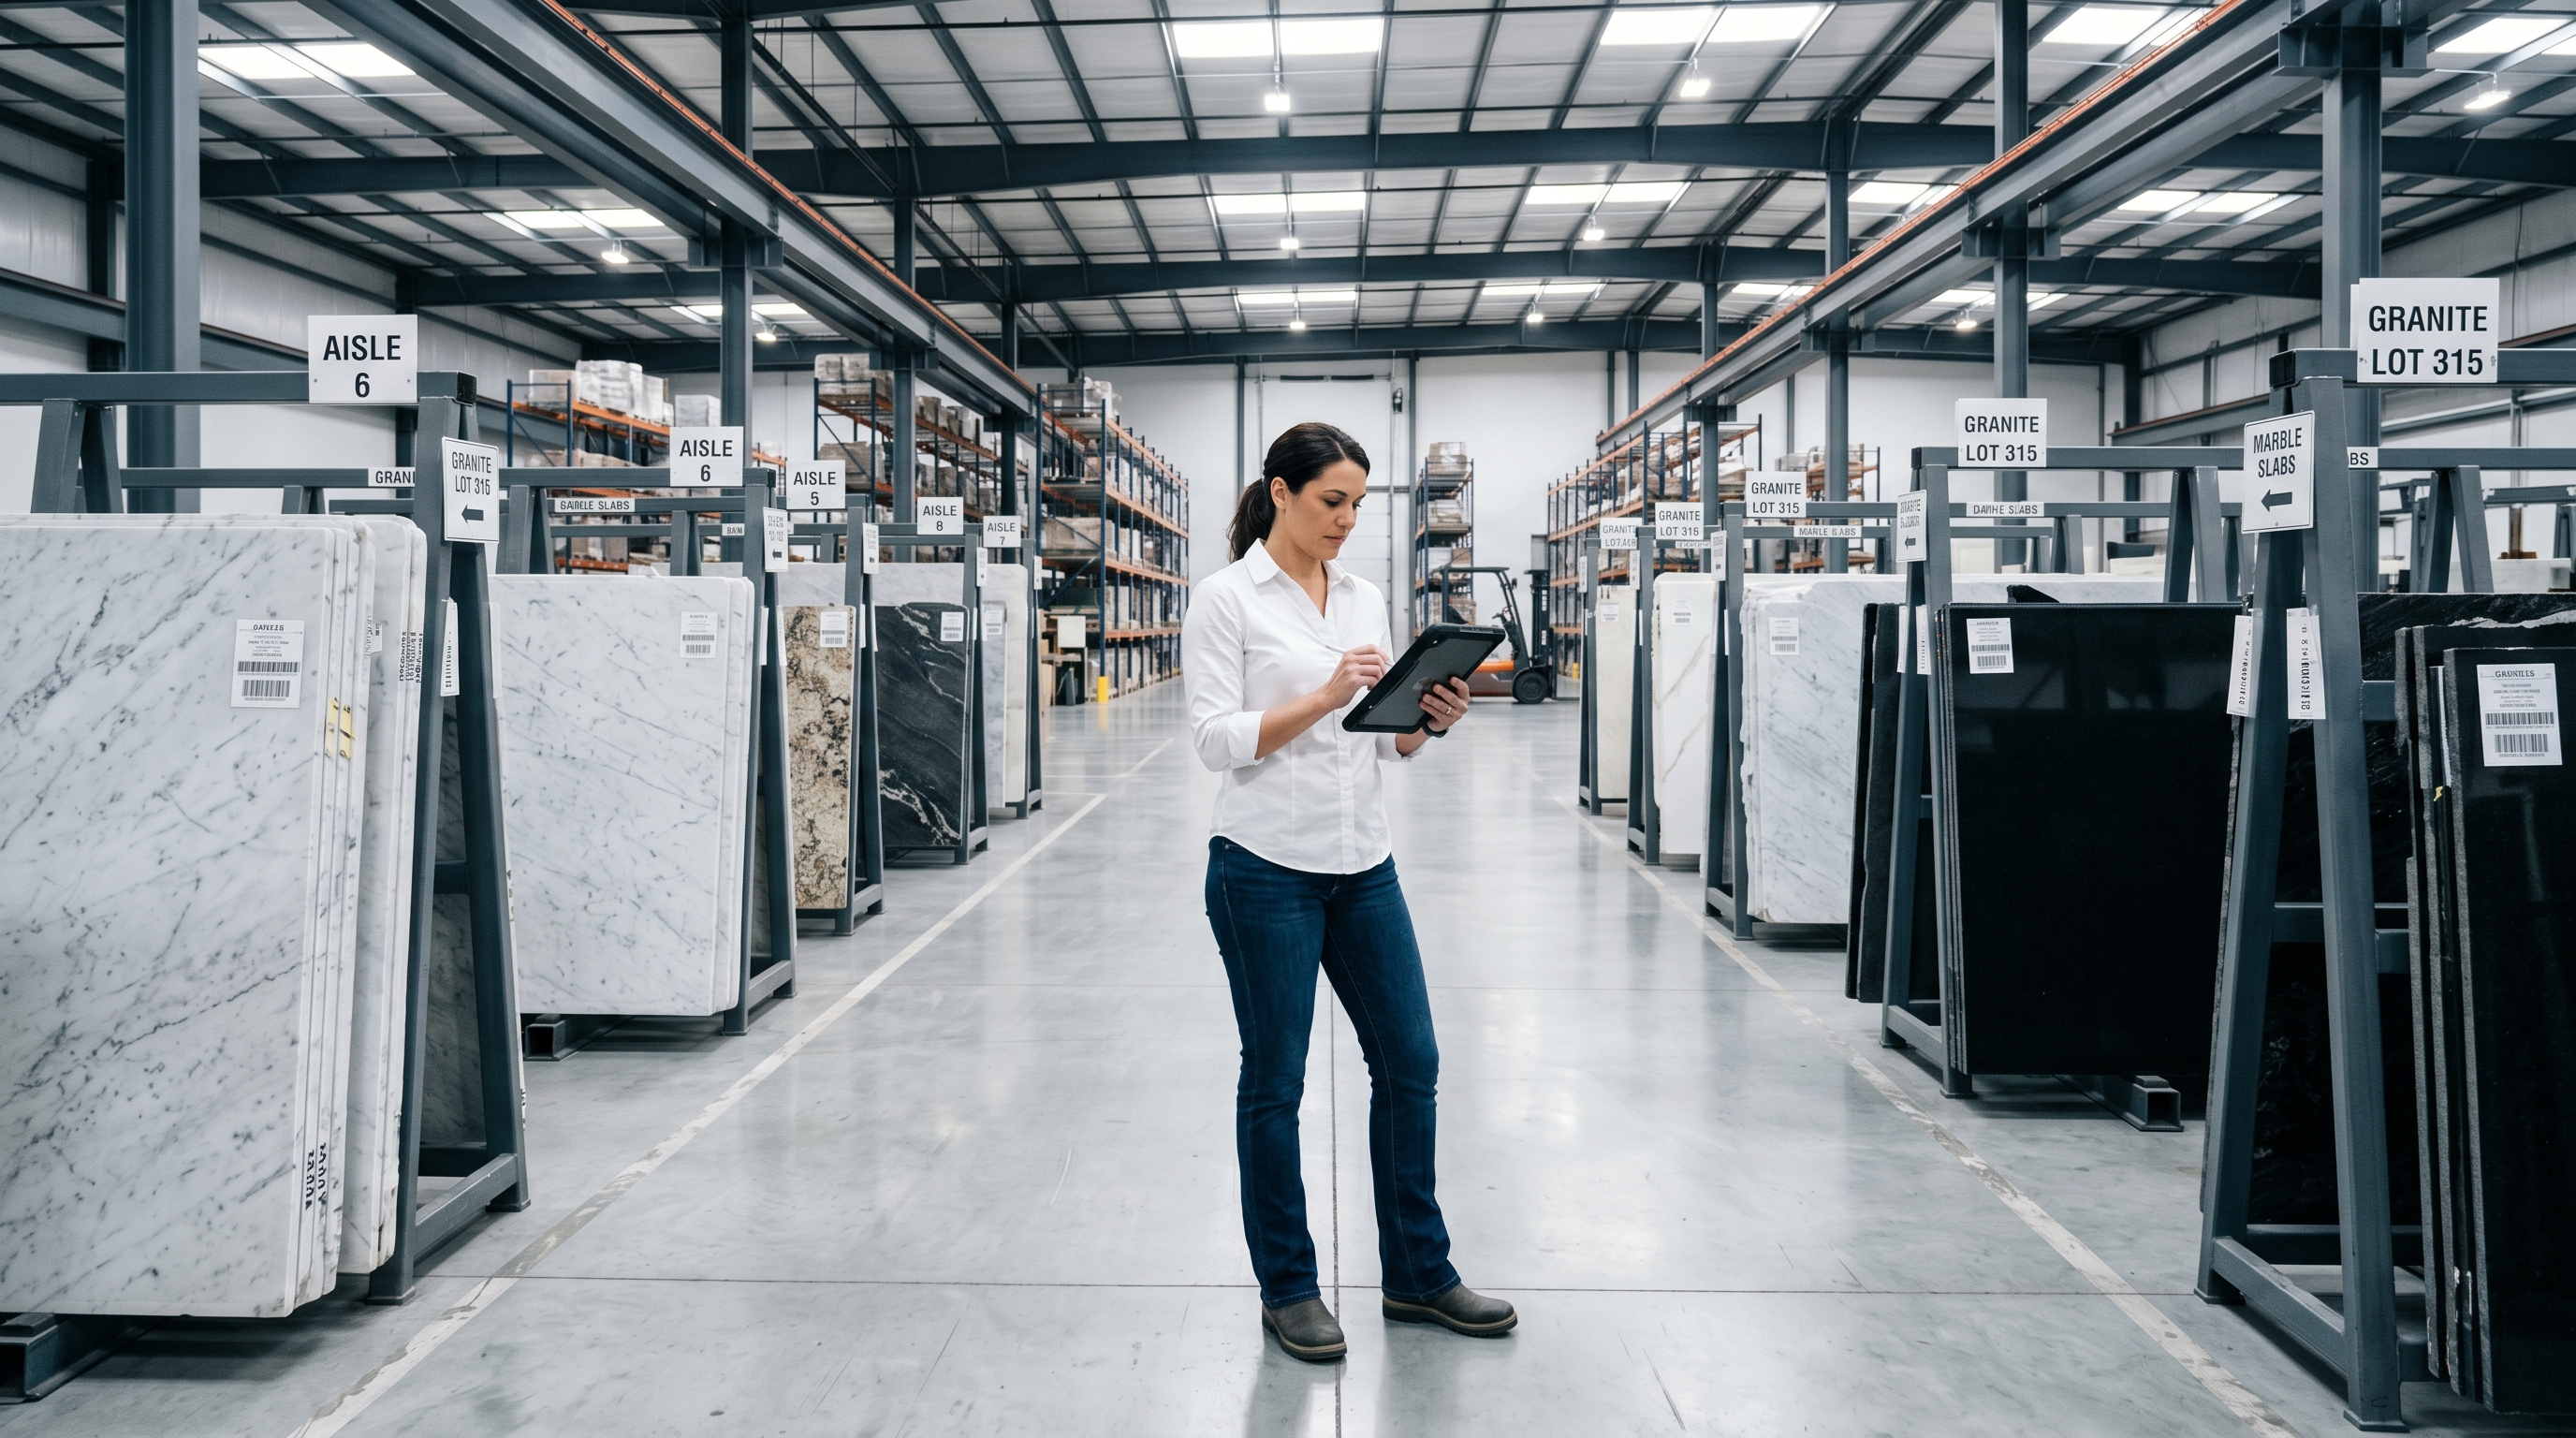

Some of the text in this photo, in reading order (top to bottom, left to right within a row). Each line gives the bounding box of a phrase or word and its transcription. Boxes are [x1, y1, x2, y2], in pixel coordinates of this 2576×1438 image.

[2368, 305, 2488, 332] GRANITE
[323, 334, 402, 361] AISLE
[2372, 348, 2483, 375] LOT 315
[355, 373, 371, 398] 6
[1964, 416, 2040, 433] GRANITE
[680, 439, 733, 458] AISLE
[2253, 427, 2303, 454] MARBLE
[1966, 444, 2038, 462] LOT 315
[451, 451, 491, 474] GRANITE
[2258, 454, 2296, 478] SLABS
[700, 464, 711, 482] 6
[793, 471, 837, 486] AISLE
[455, 475, 472, 493] LOT
[1751, 481, 1802, 495] GRANITE
[598, 500, 630, 510] SLABS
[811, 492, 820, 506] 5
[923, 506, 958, 517] AISLE
[1659, 510, 1701, 521] GRANITE
[1752, 502, 1800, 514] LOT 315
[936, 521, 944, 532] 8
[988, 522, 1016, 532] AISLE
[1660, 527, 1678, 536] LOT
[1000, 536, 1005, 546] 7
